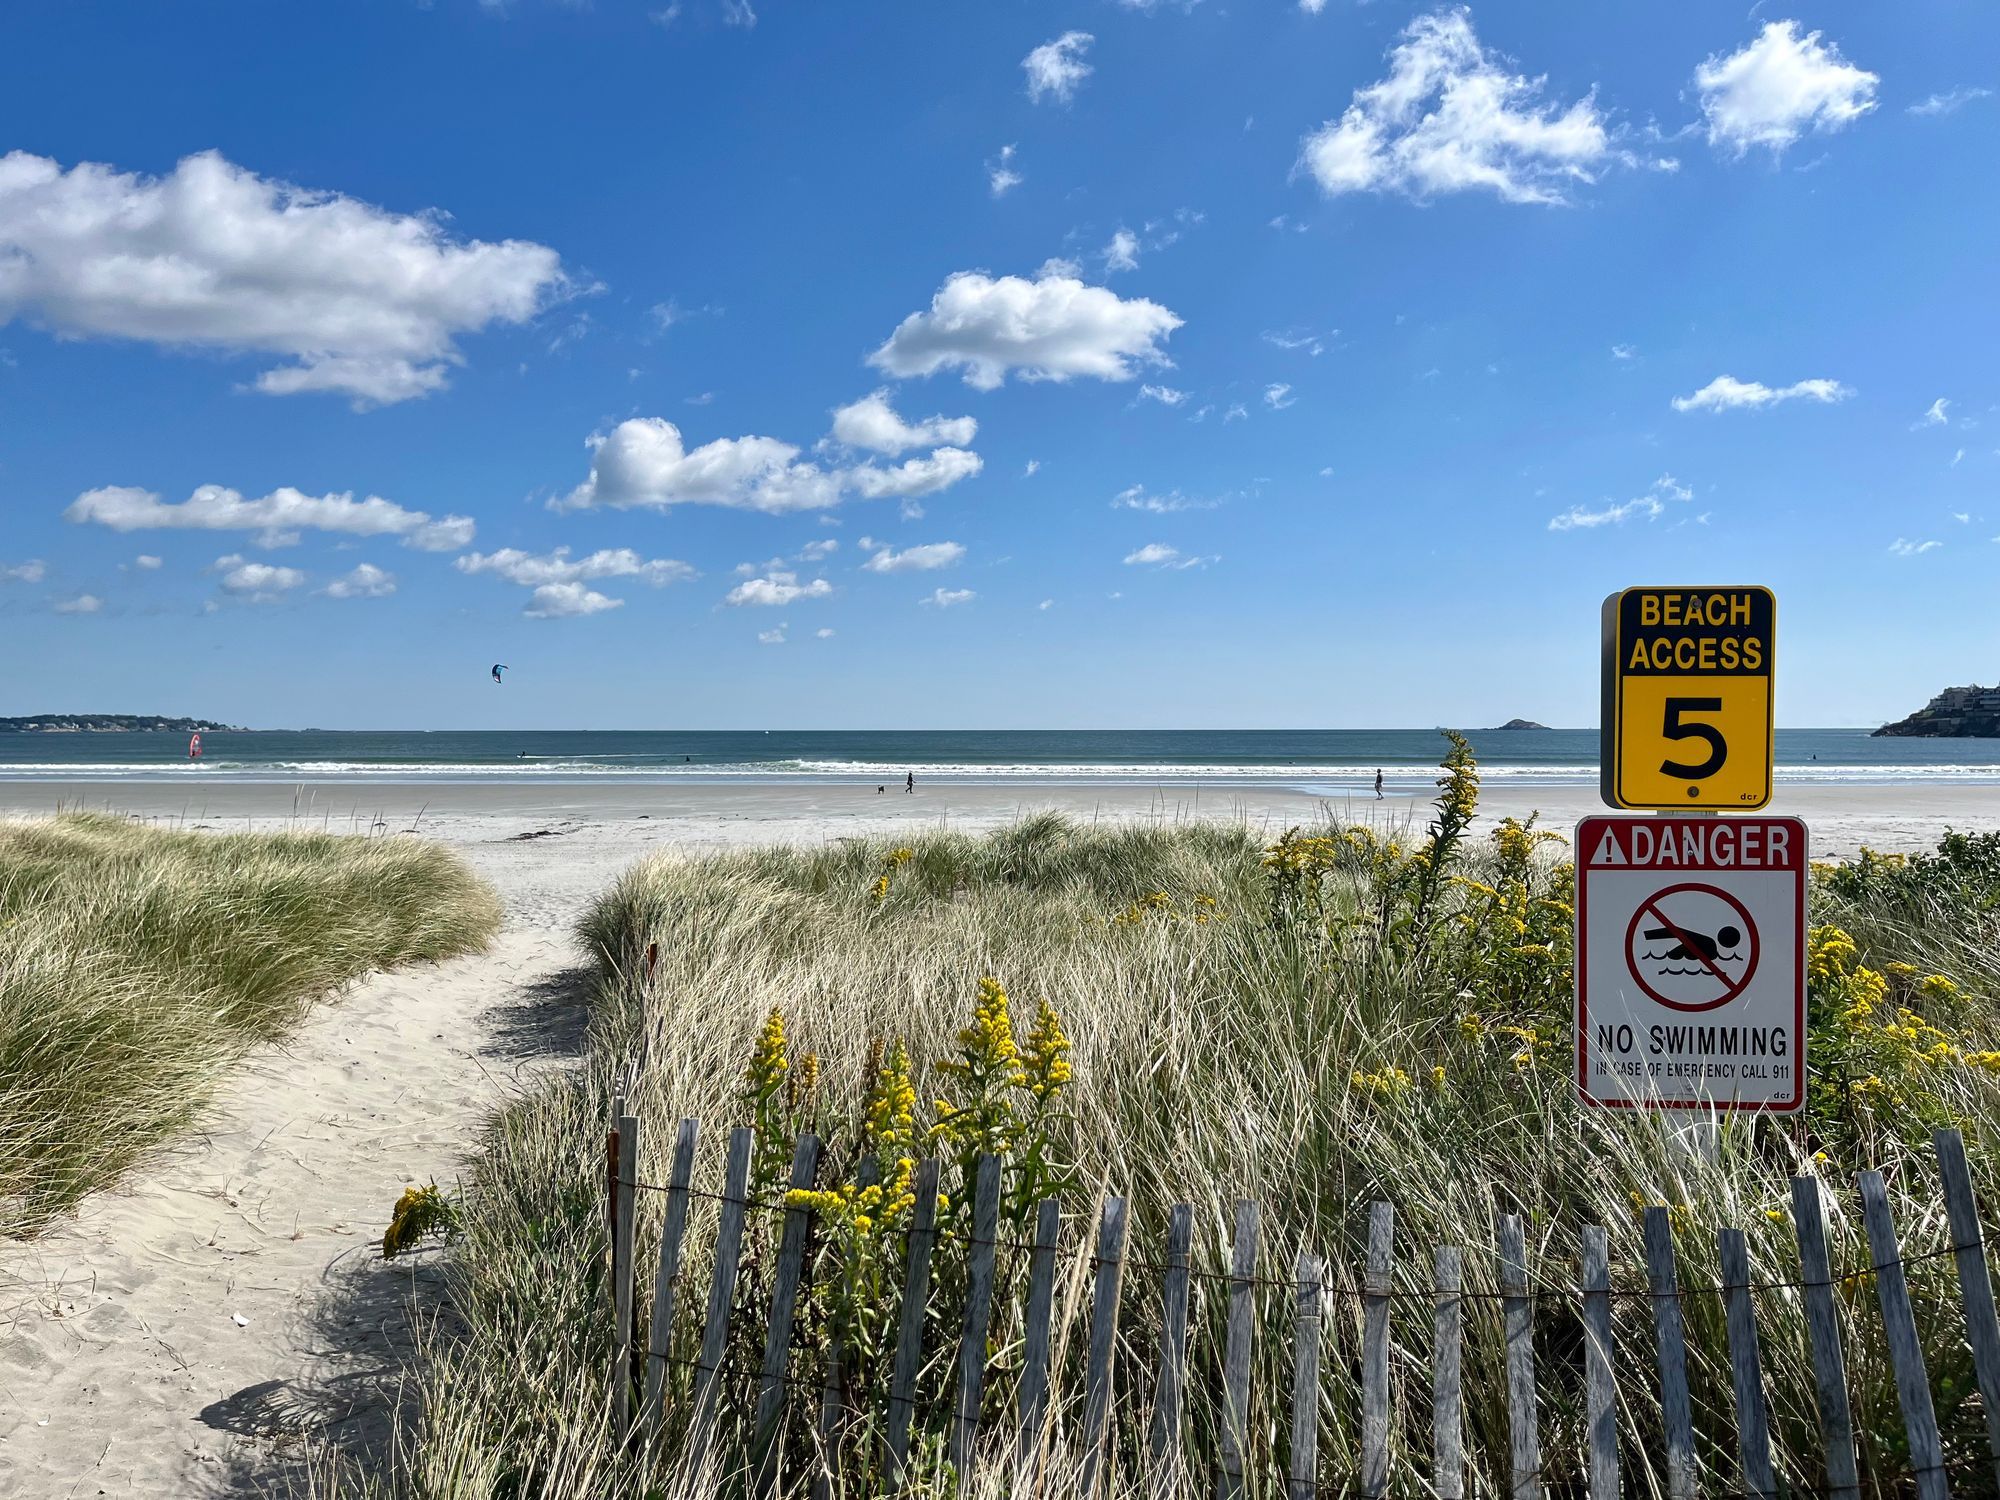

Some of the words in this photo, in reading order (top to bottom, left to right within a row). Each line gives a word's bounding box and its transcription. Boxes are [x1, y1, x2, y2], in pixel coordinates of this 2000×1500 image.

[1641, 594, 1750, 626] BEACH
[1629, 637, 1762, 670] ACCESS
[1659, 697, 1728, 780] 5
[1740, 792, 1758, 801] dcr
[1631, 824, 1789, 867] DANGER
[1598, 1024, 1633, 1054] NO
[1650, 1024, 1787, 1057] SWIMMING
[1596, 1062, 1607, 1076] IN
[1648, 1062, 1662, 1077] OF
[1741, 1064, 1768, 1079] CALL
[1773, 1064, 1789, 1079] 911
[1773, 1091, 1790, 1099] dcr
